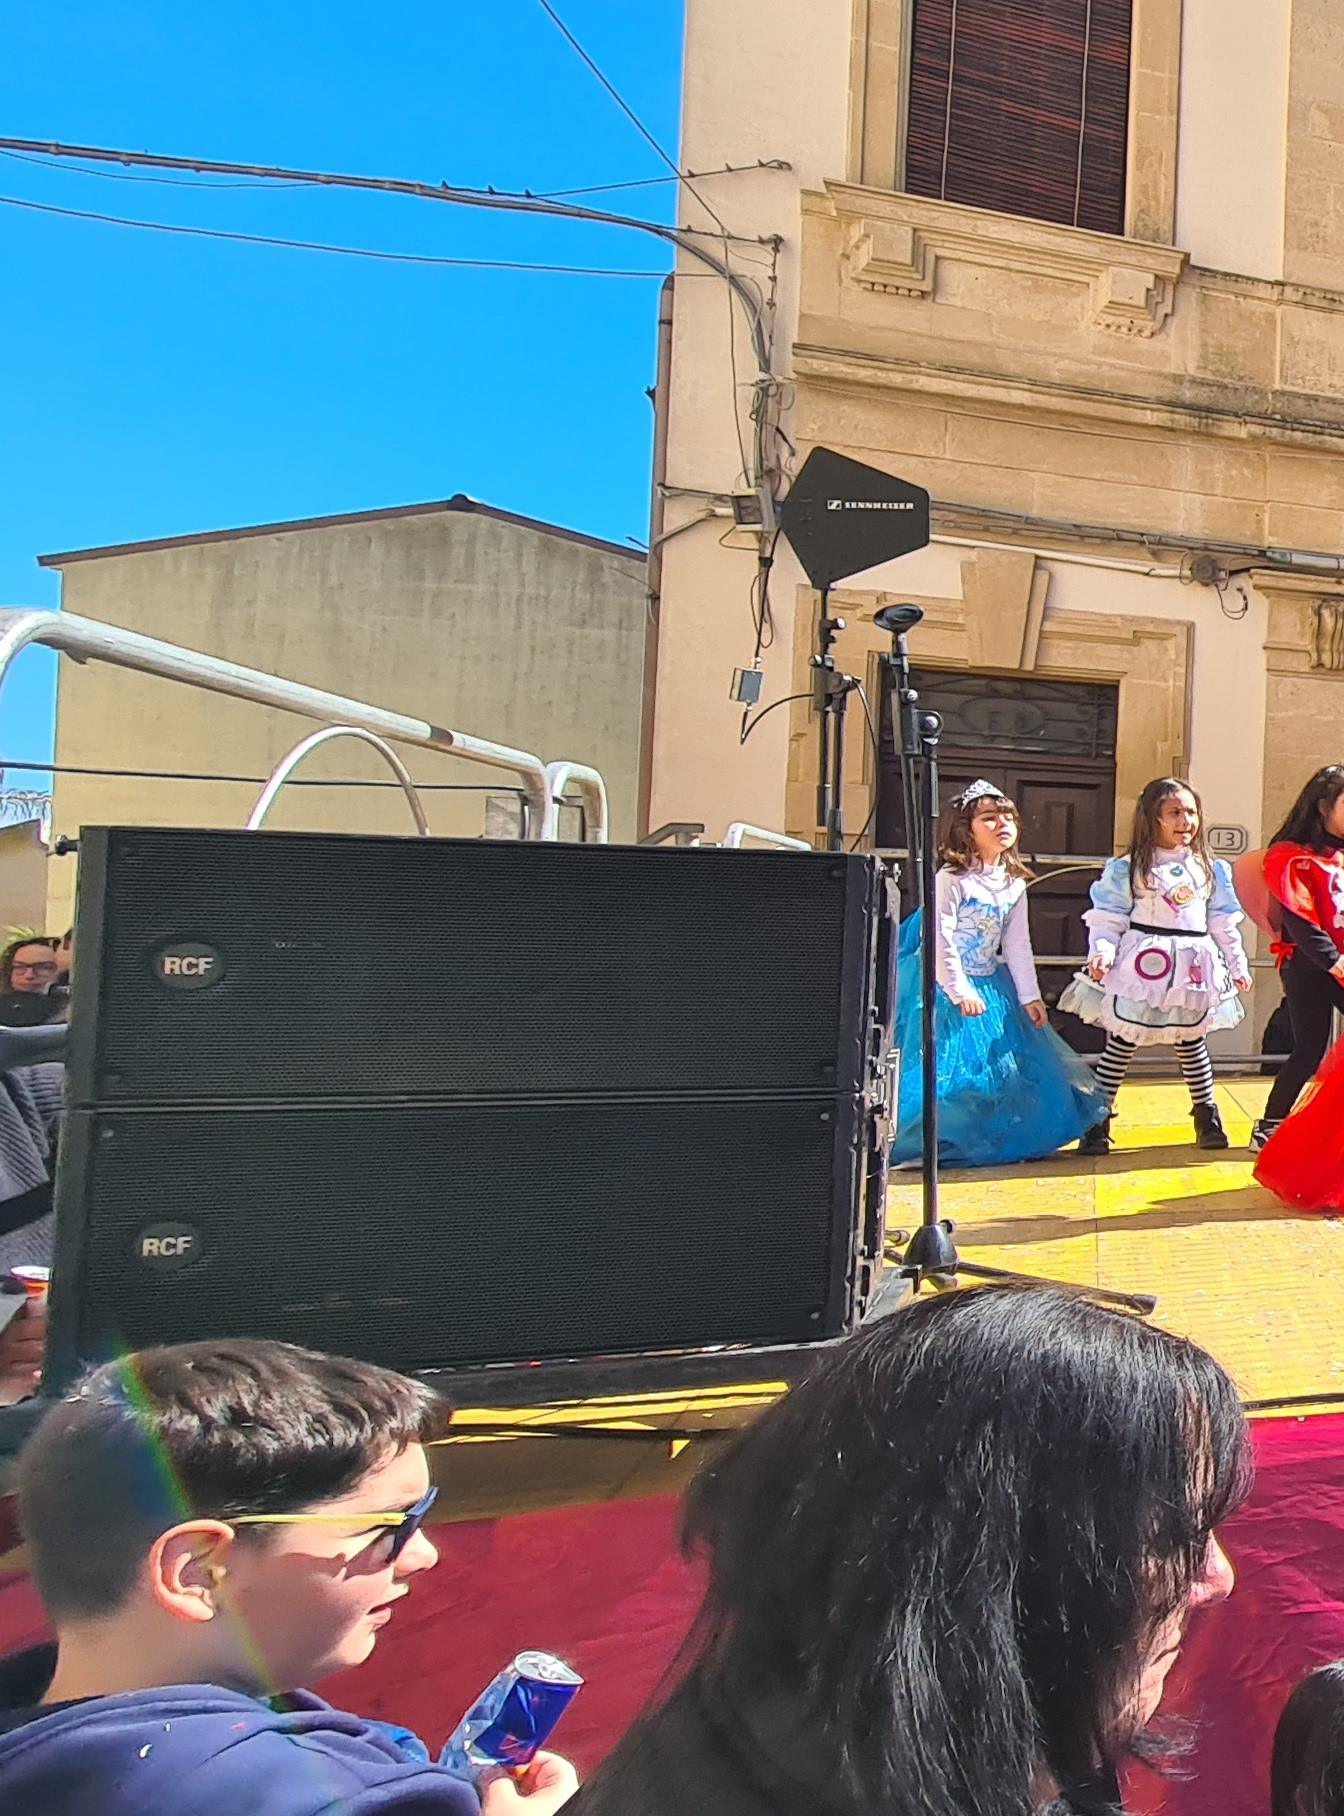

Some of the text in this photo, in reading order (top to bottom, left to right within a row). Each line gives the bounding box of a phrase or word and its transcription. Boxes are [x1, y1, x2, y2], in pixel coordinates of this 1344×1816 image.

[844, 501, 914, 510] SENNHEISER
[1217, 831, 1236, 847] 13
[163, 956, 214, 975] RCF
[142, 1236, 192, 1257] RCF
